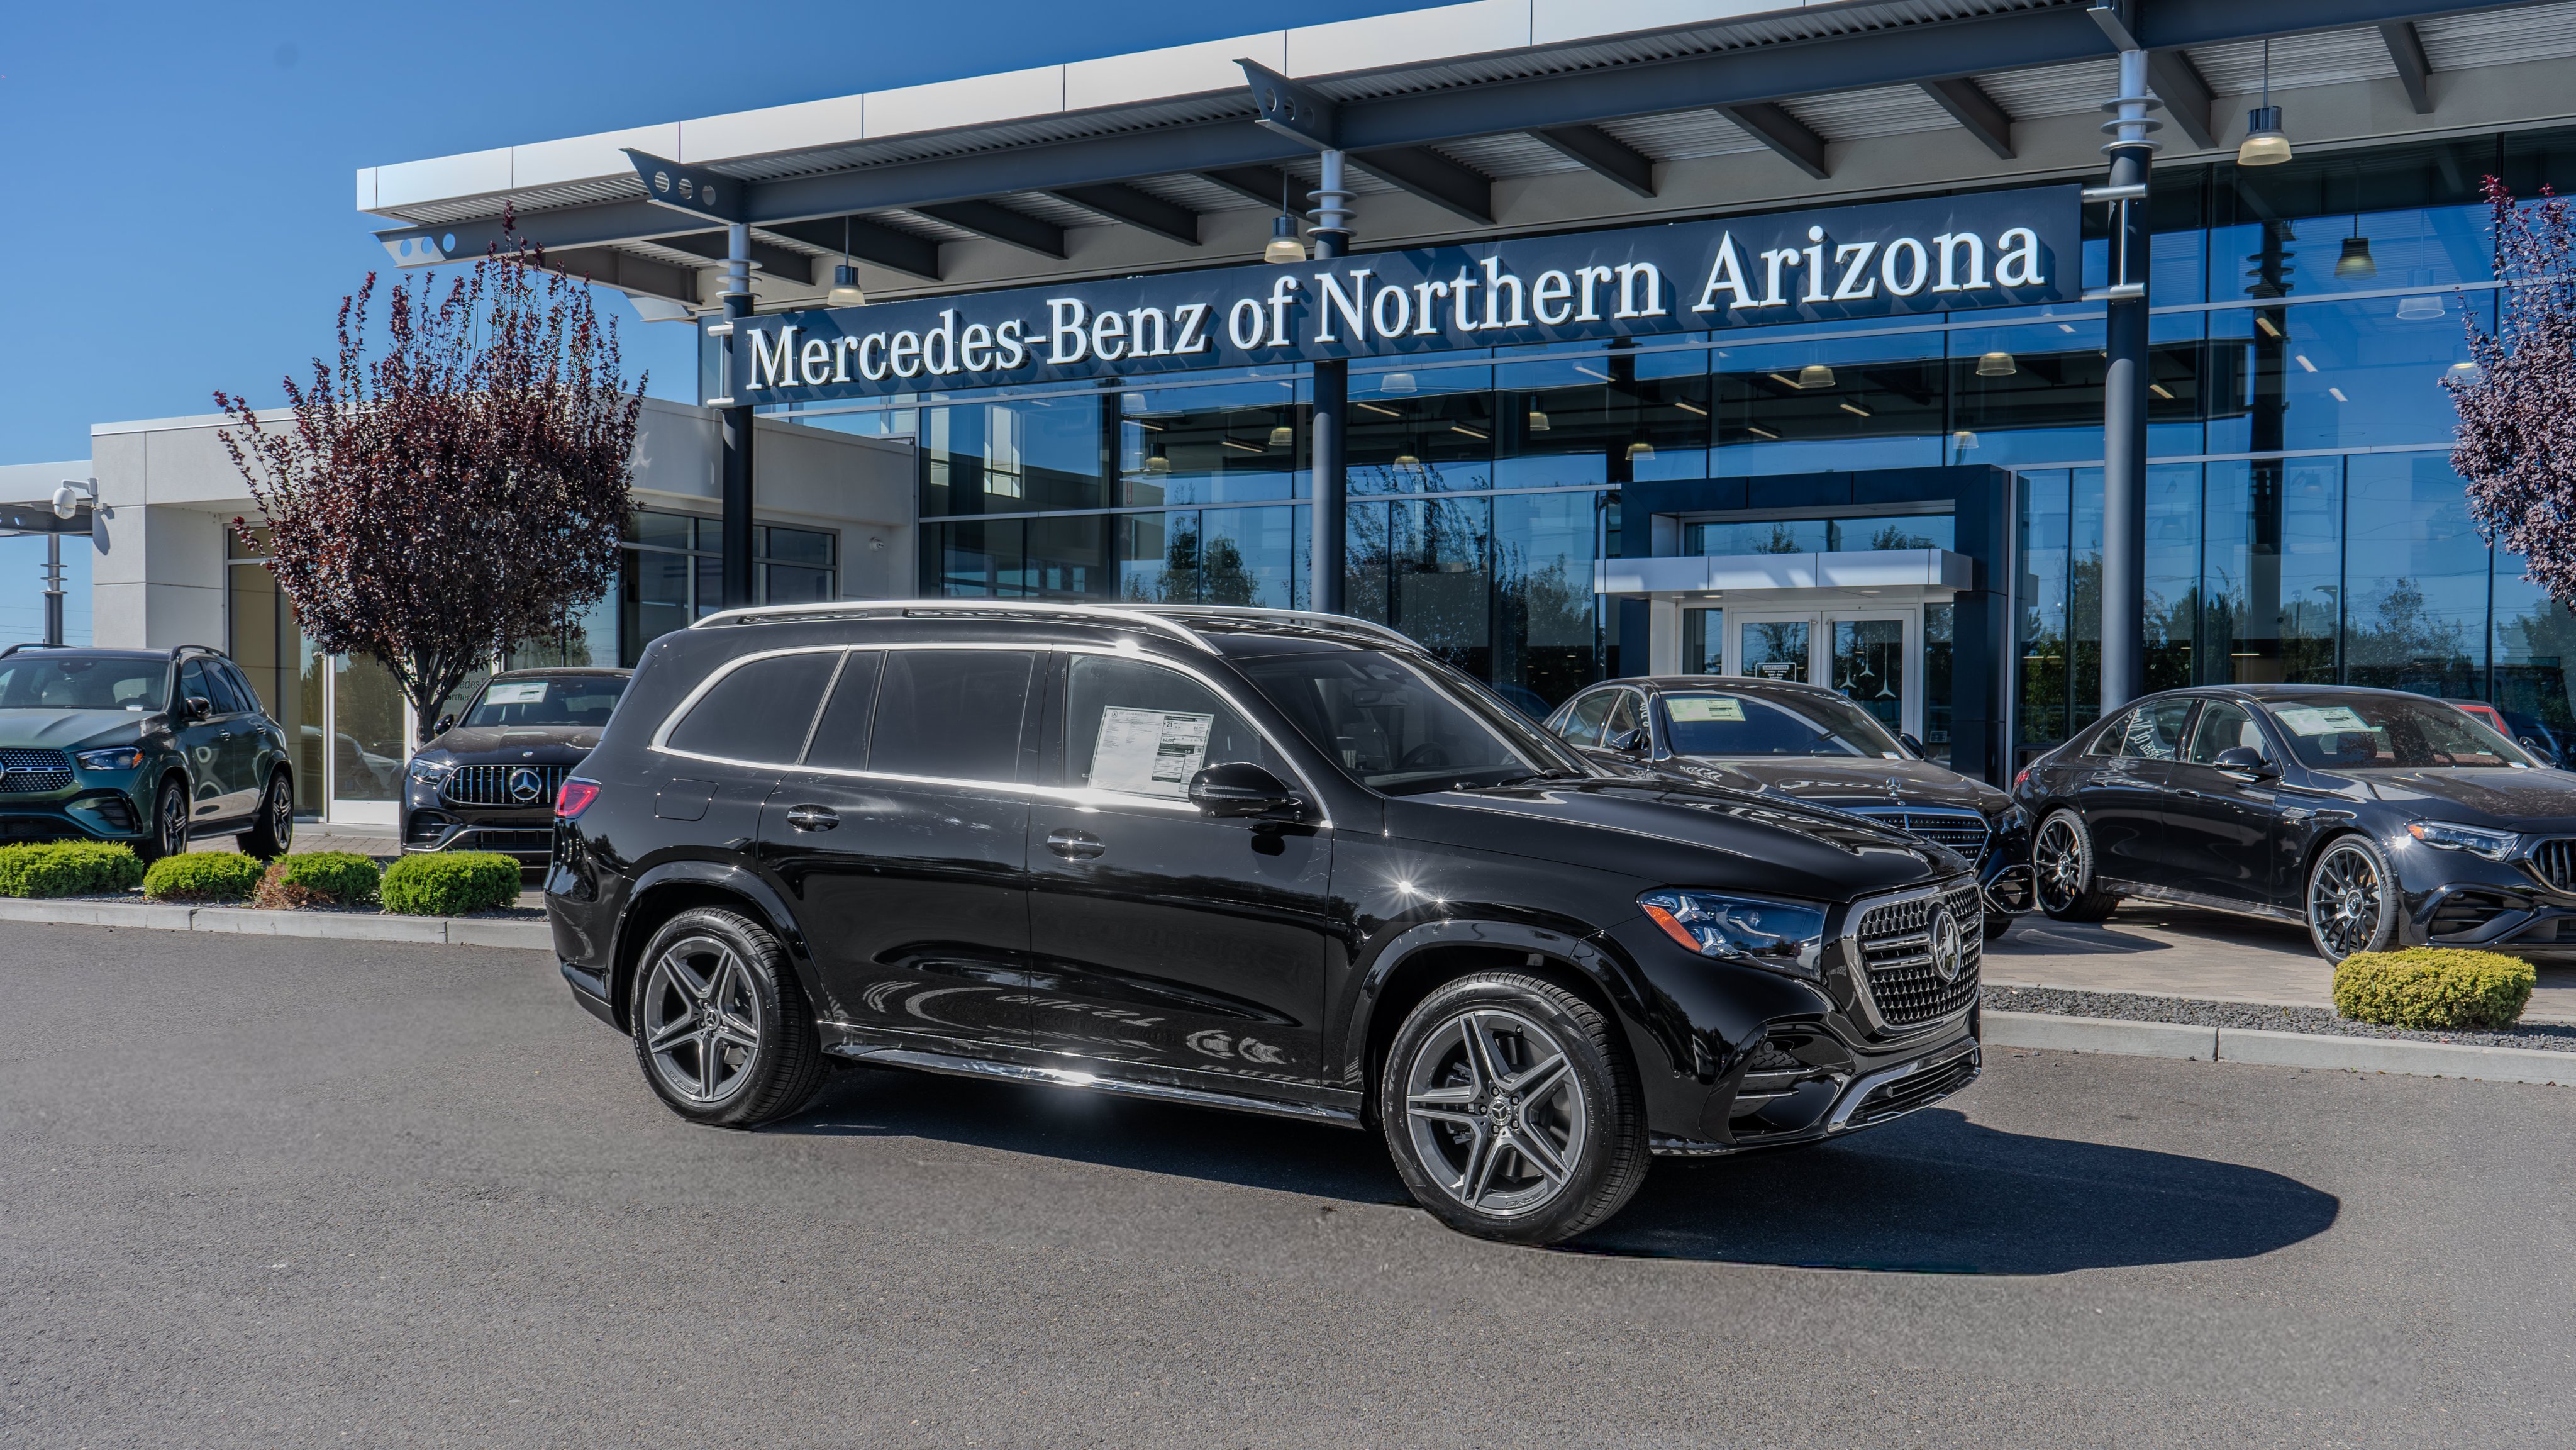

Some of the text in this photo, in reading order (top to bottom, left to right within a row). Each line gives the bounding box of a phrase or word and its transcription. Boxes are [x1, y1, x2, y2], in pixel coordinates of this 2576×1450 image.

[745, 225, 2045, 390] Mercedes-Benz of Northern Arizona
